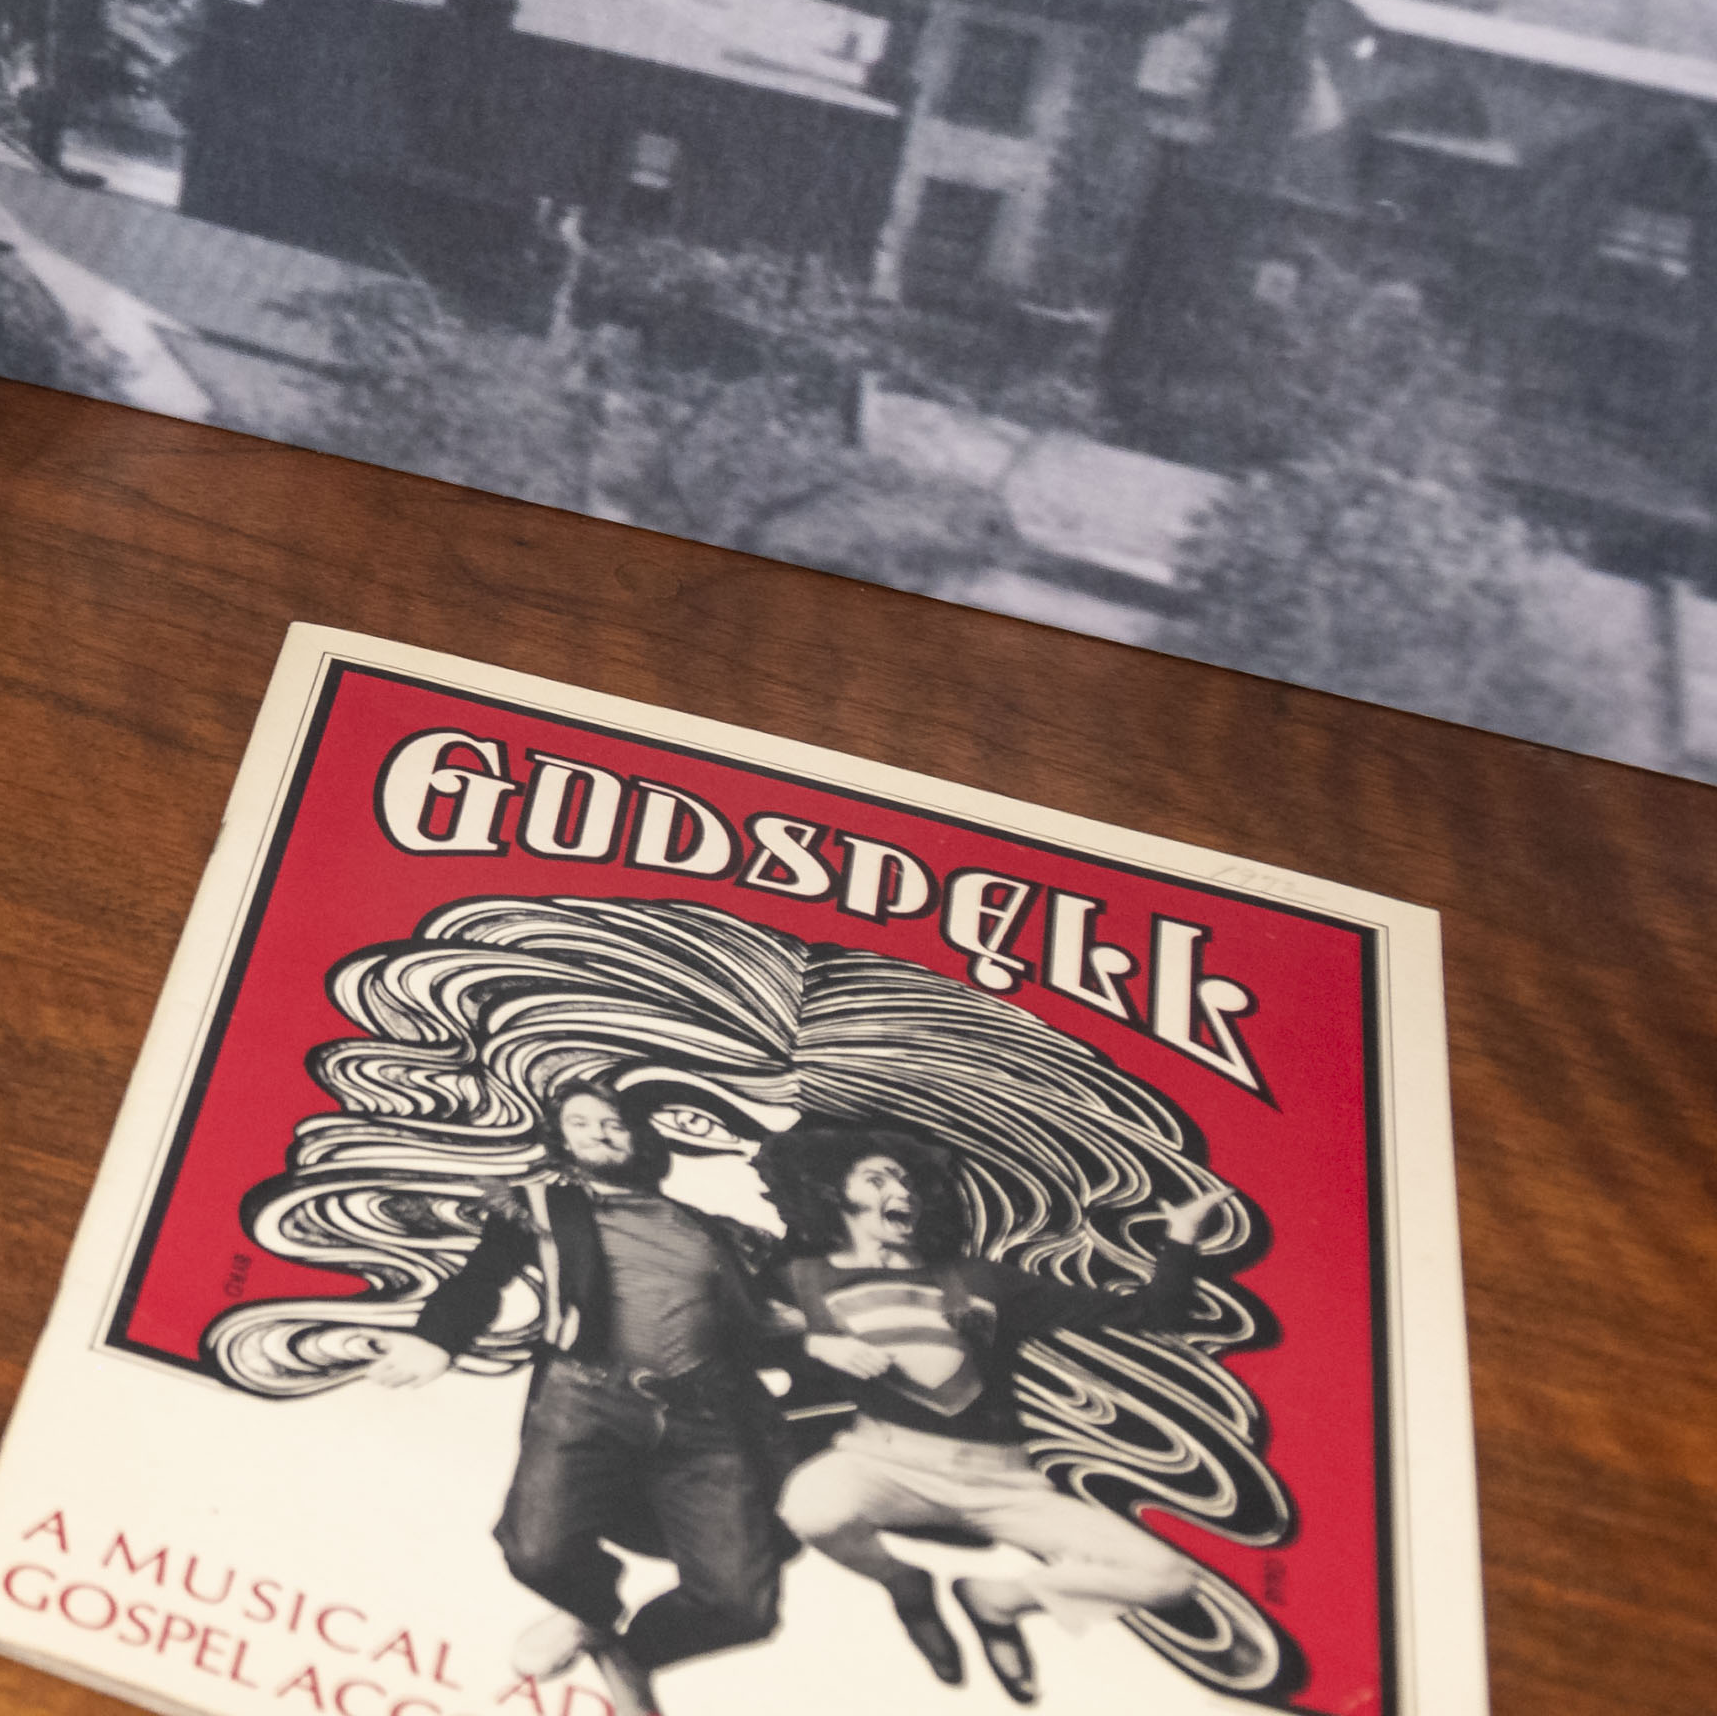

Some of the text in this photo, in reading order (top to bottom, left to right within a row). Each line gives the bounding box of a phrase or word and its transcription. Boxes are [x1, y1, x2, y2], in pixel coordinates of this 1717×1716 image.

[377, 726, 1277, 1106] GODSPELL
[1, 1562, 259, 1688] GOSPEL
[21, 1509, 71, 1553] A
[100, 1530, 463, 1691] MUSICAL
